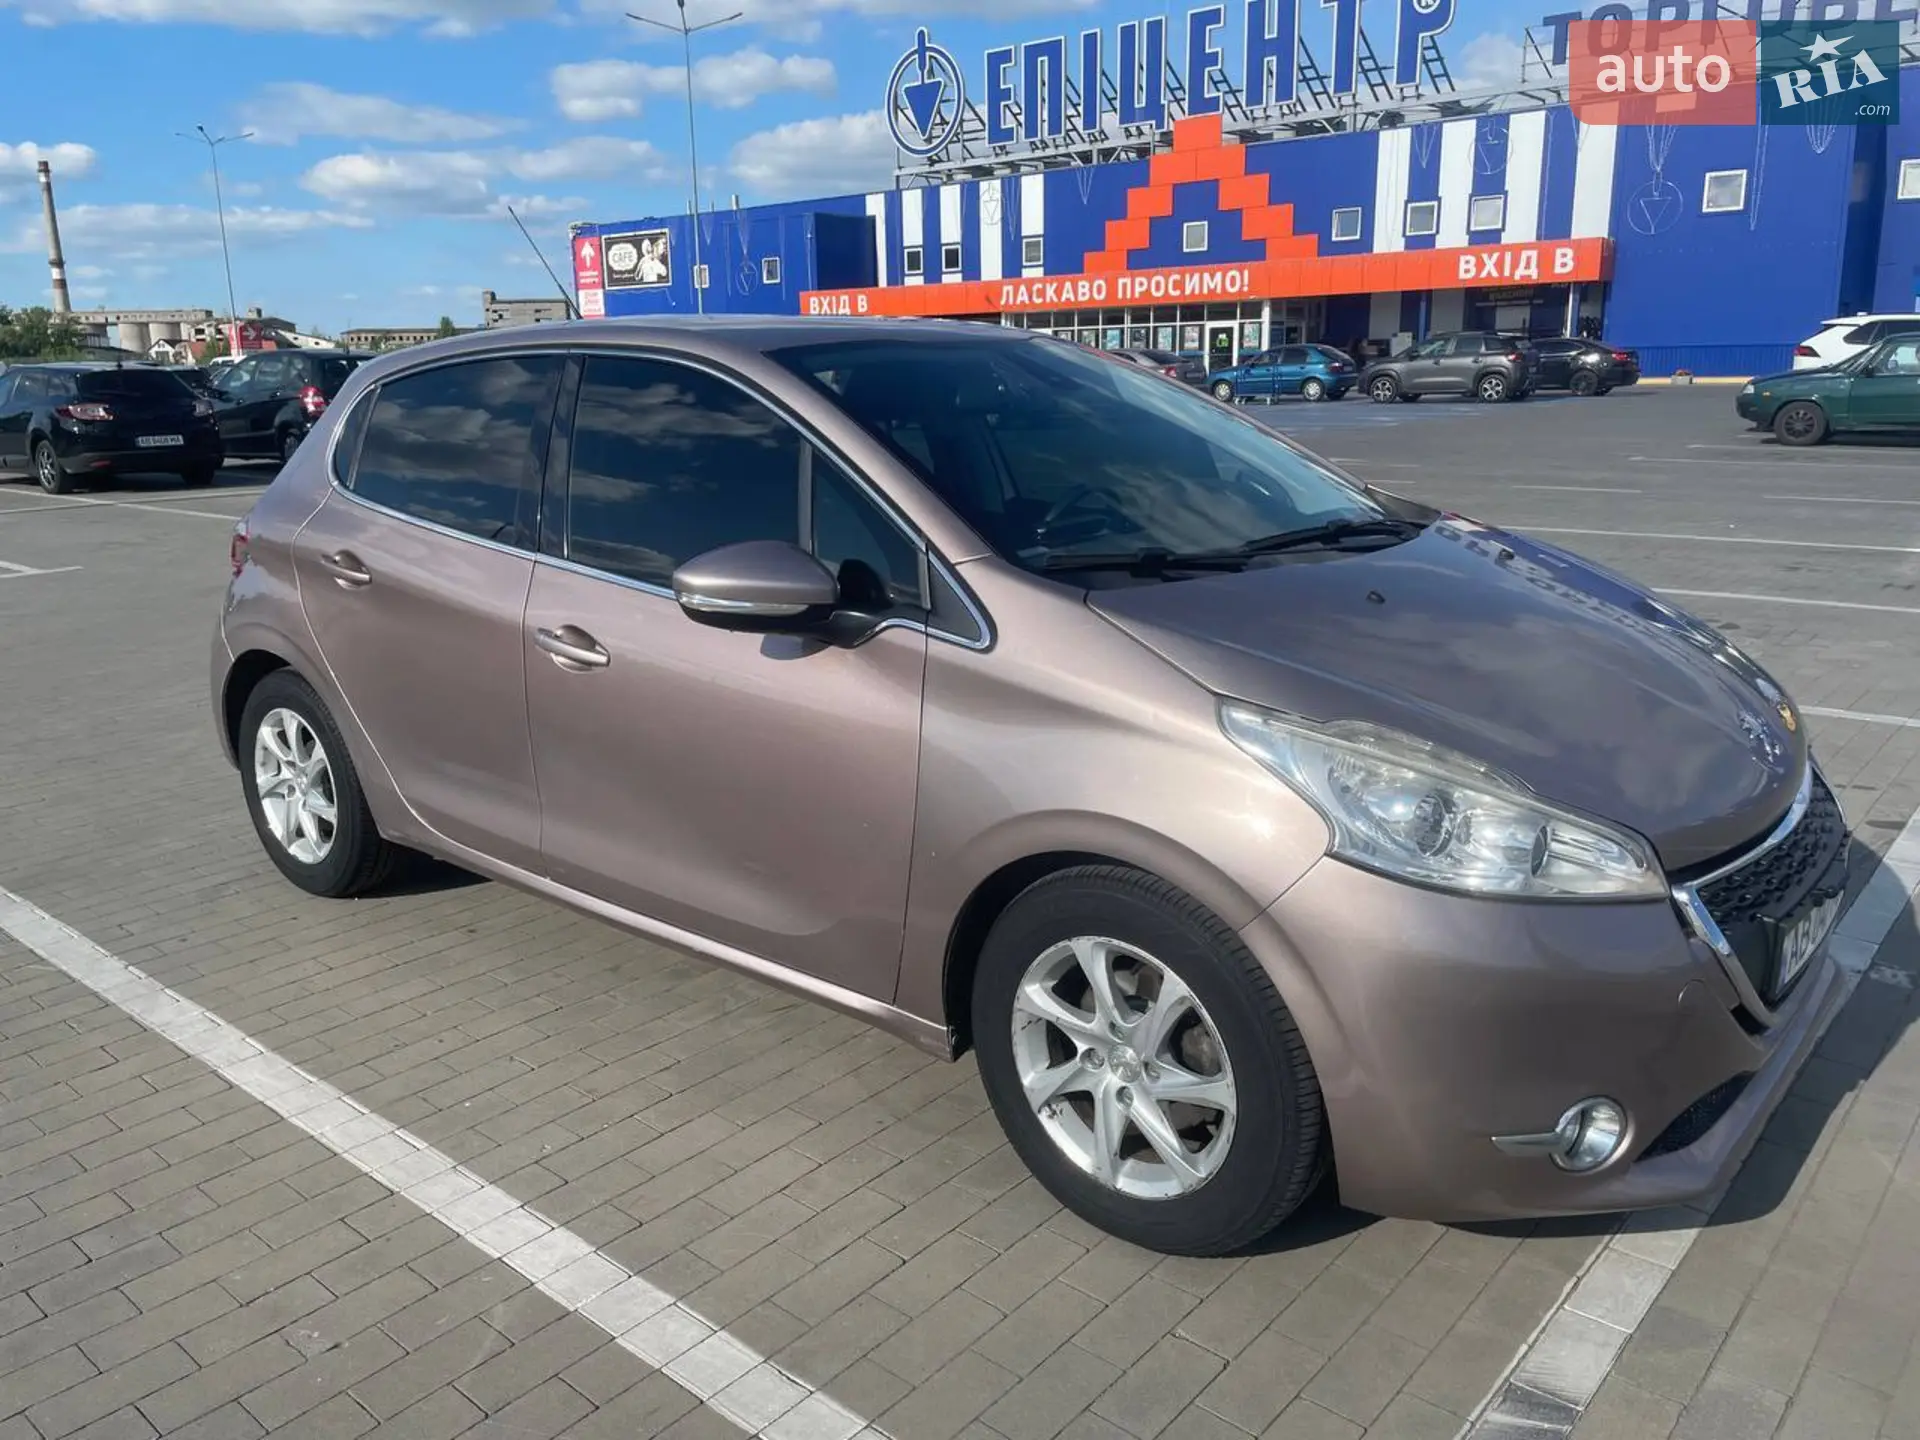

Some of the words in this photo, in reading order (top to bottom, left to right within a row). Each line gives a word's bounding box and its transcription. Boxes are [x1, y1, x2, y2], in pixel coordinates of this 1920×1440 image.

[985, 0, 1455, 147] ЕПІЦЕНТР
[1458, 249, 1539, 281] ВХІД
[1553, 247, 1575, 275] В
[809, 294, 851, 315] ВХІД
[857, 294, 868, 313] В
[1000, 280, 1107, 306] ЛАСКАВО
[1117, 269, 1249, 299] ПРОСИМО!
